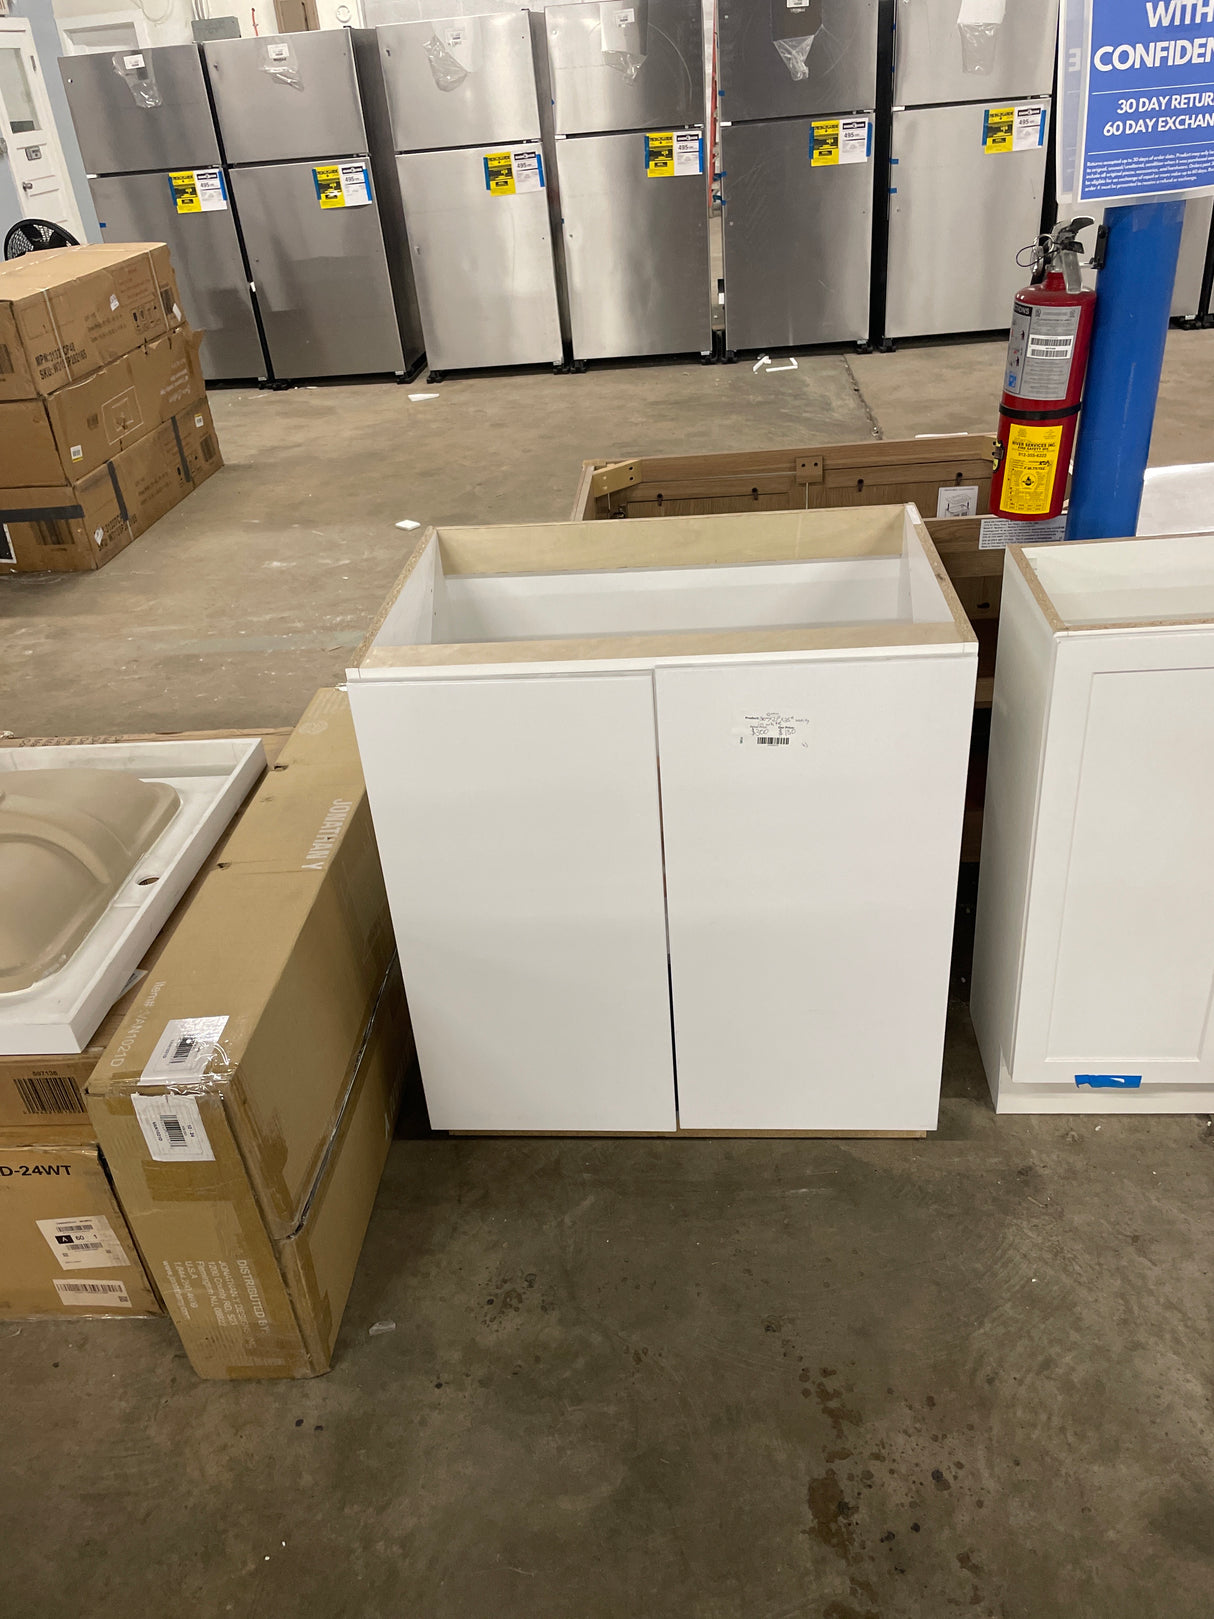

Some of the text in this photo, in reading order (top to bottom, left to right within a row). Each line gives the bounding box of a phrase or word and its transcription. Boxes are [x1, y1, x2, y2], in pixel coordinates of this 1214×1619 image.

[1146, 0, 1214, 27] WITH
[1116, 92, 1214, 114] 30 DAY RETUR
[1103, 121, 1124, 137] 60
[1125, 118, 1156, 134] DAY
[301, 798, 352, 870] JONATHAN Y
[237, 1260, 265, 1318] DISTRIBUTED
